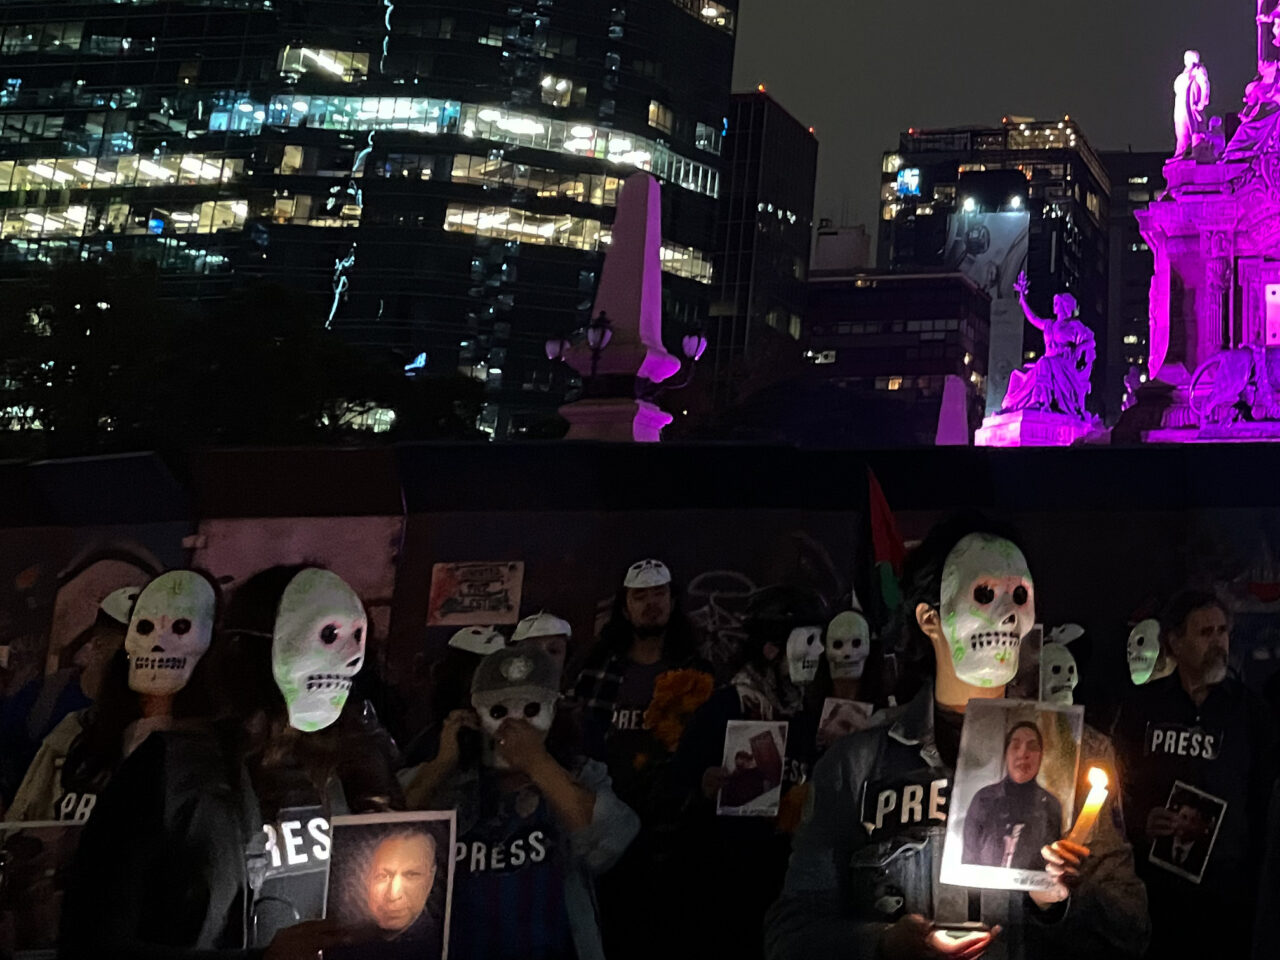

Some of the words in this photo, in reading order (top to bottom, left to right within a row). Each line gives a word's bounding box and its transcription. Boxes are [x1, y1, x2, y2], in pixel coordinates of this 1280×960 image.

[1151, 729, 1215, 759] PRESS
[875, 778, 949, 830] PRE
[456, 830, 546, 873] PRESS
